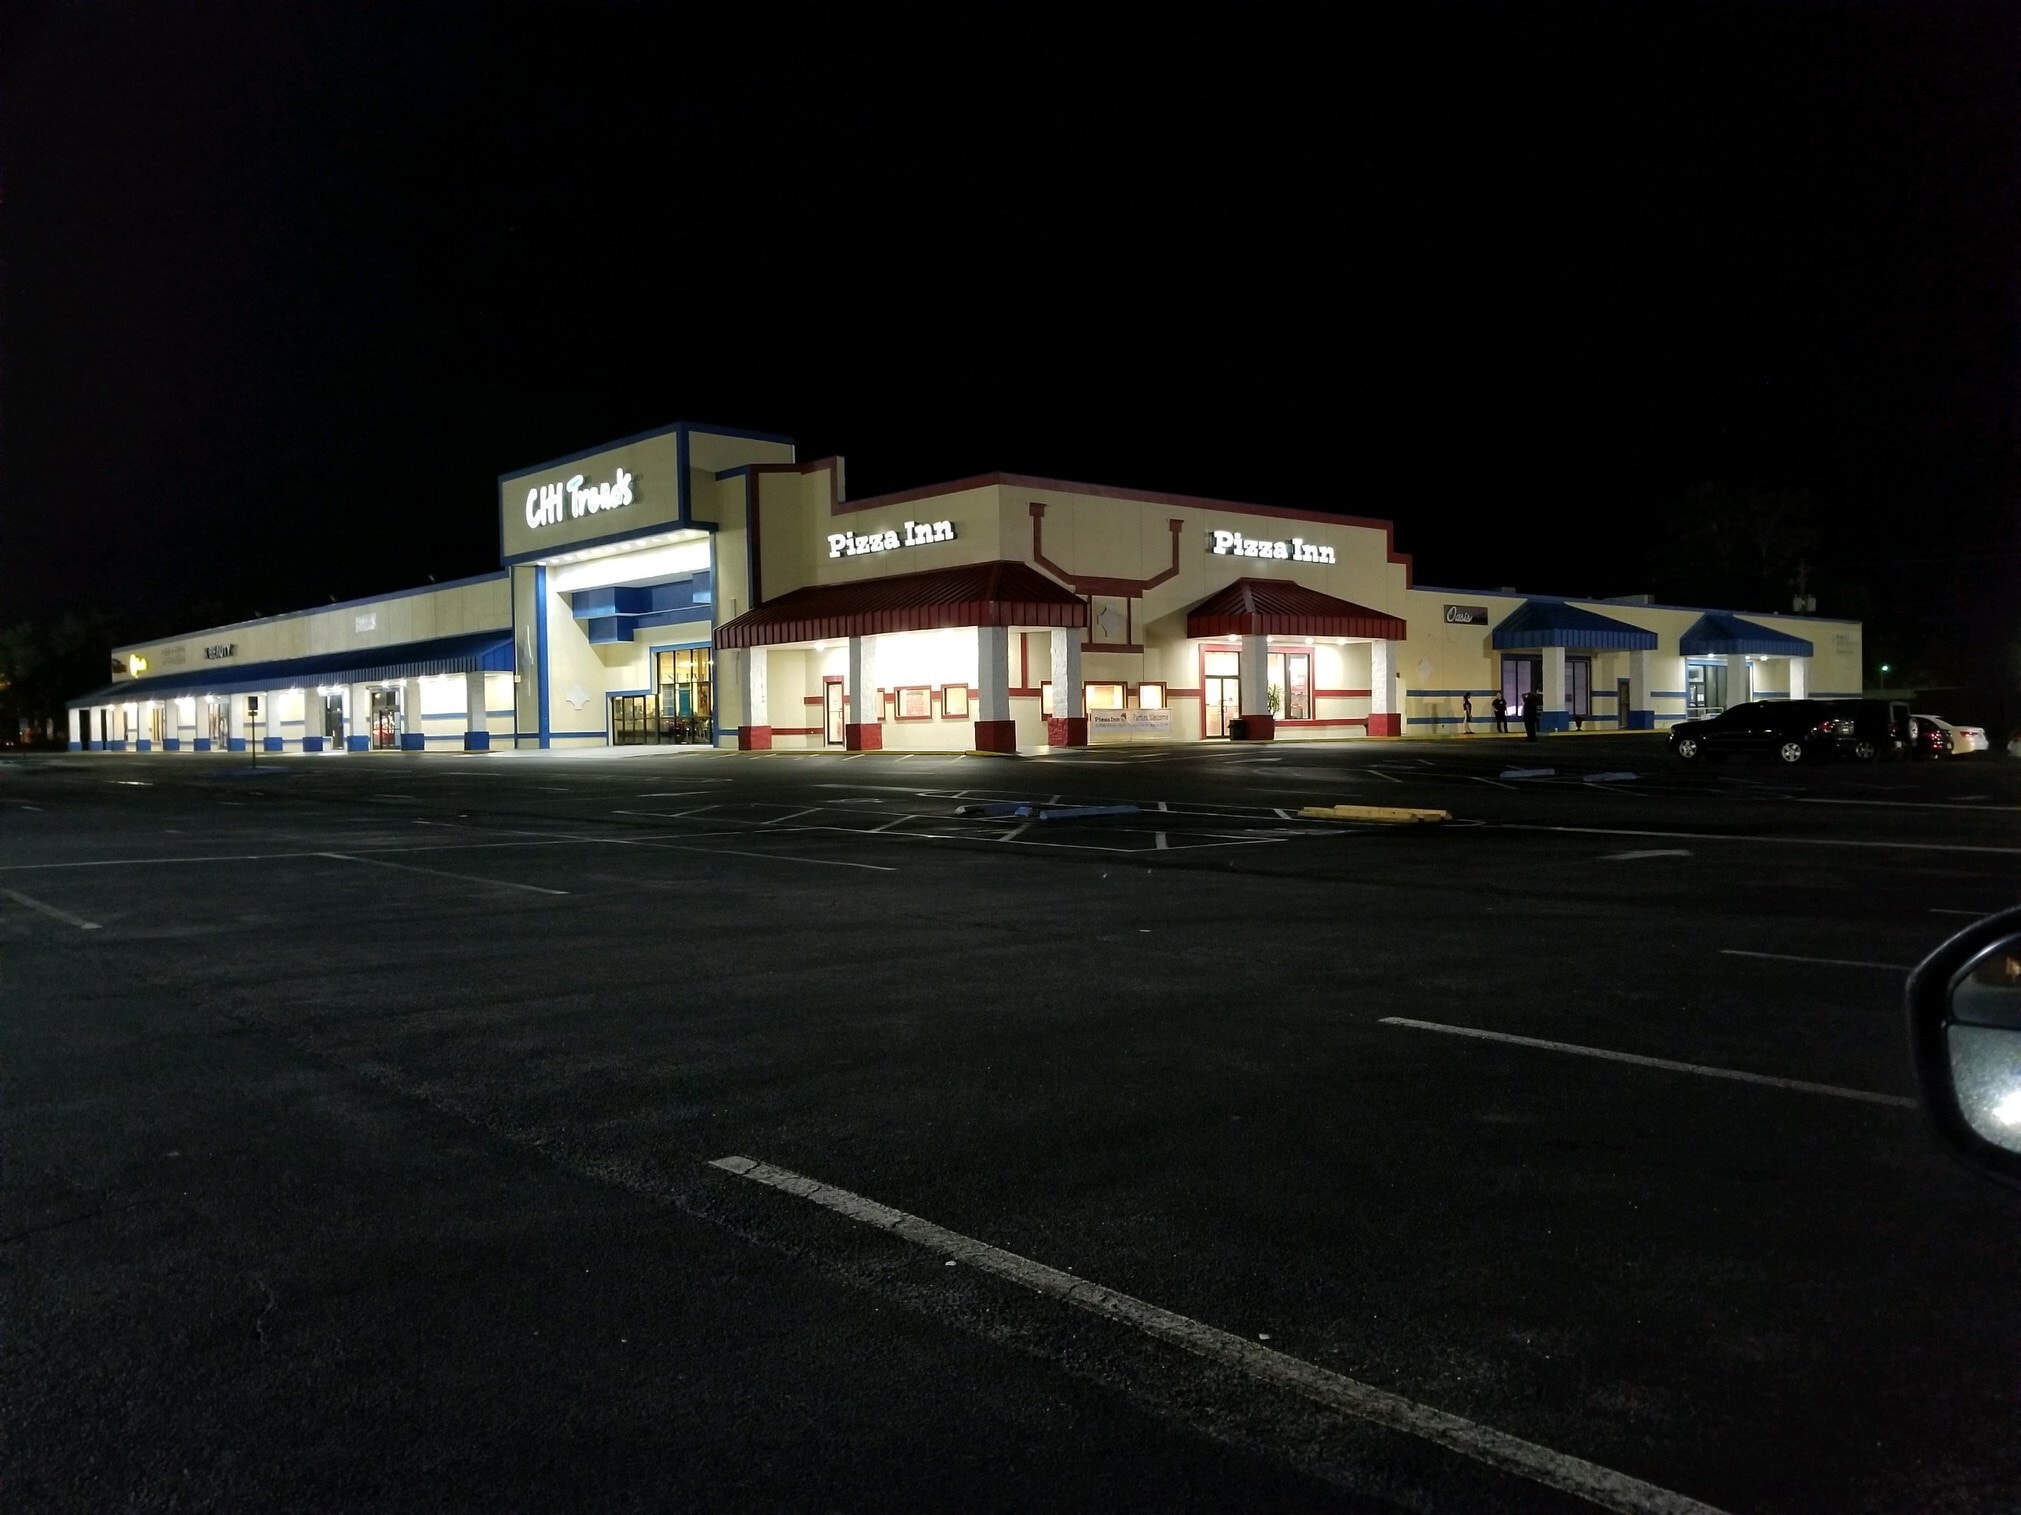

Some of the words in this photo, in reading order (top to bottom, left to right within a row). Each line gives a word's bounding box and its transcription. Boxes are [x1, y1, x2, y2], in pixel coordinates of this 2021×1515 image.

[828, 530, 900, 558] Pizza
[904, 520, 954, 546] Inn
[1213, 531, 1288, 558] Pizza
[1292, 538, 1336, 564] Inn
[1446, 606, 1473, 622] Oasis
[207, 643, 233, 659] BEAUTY
